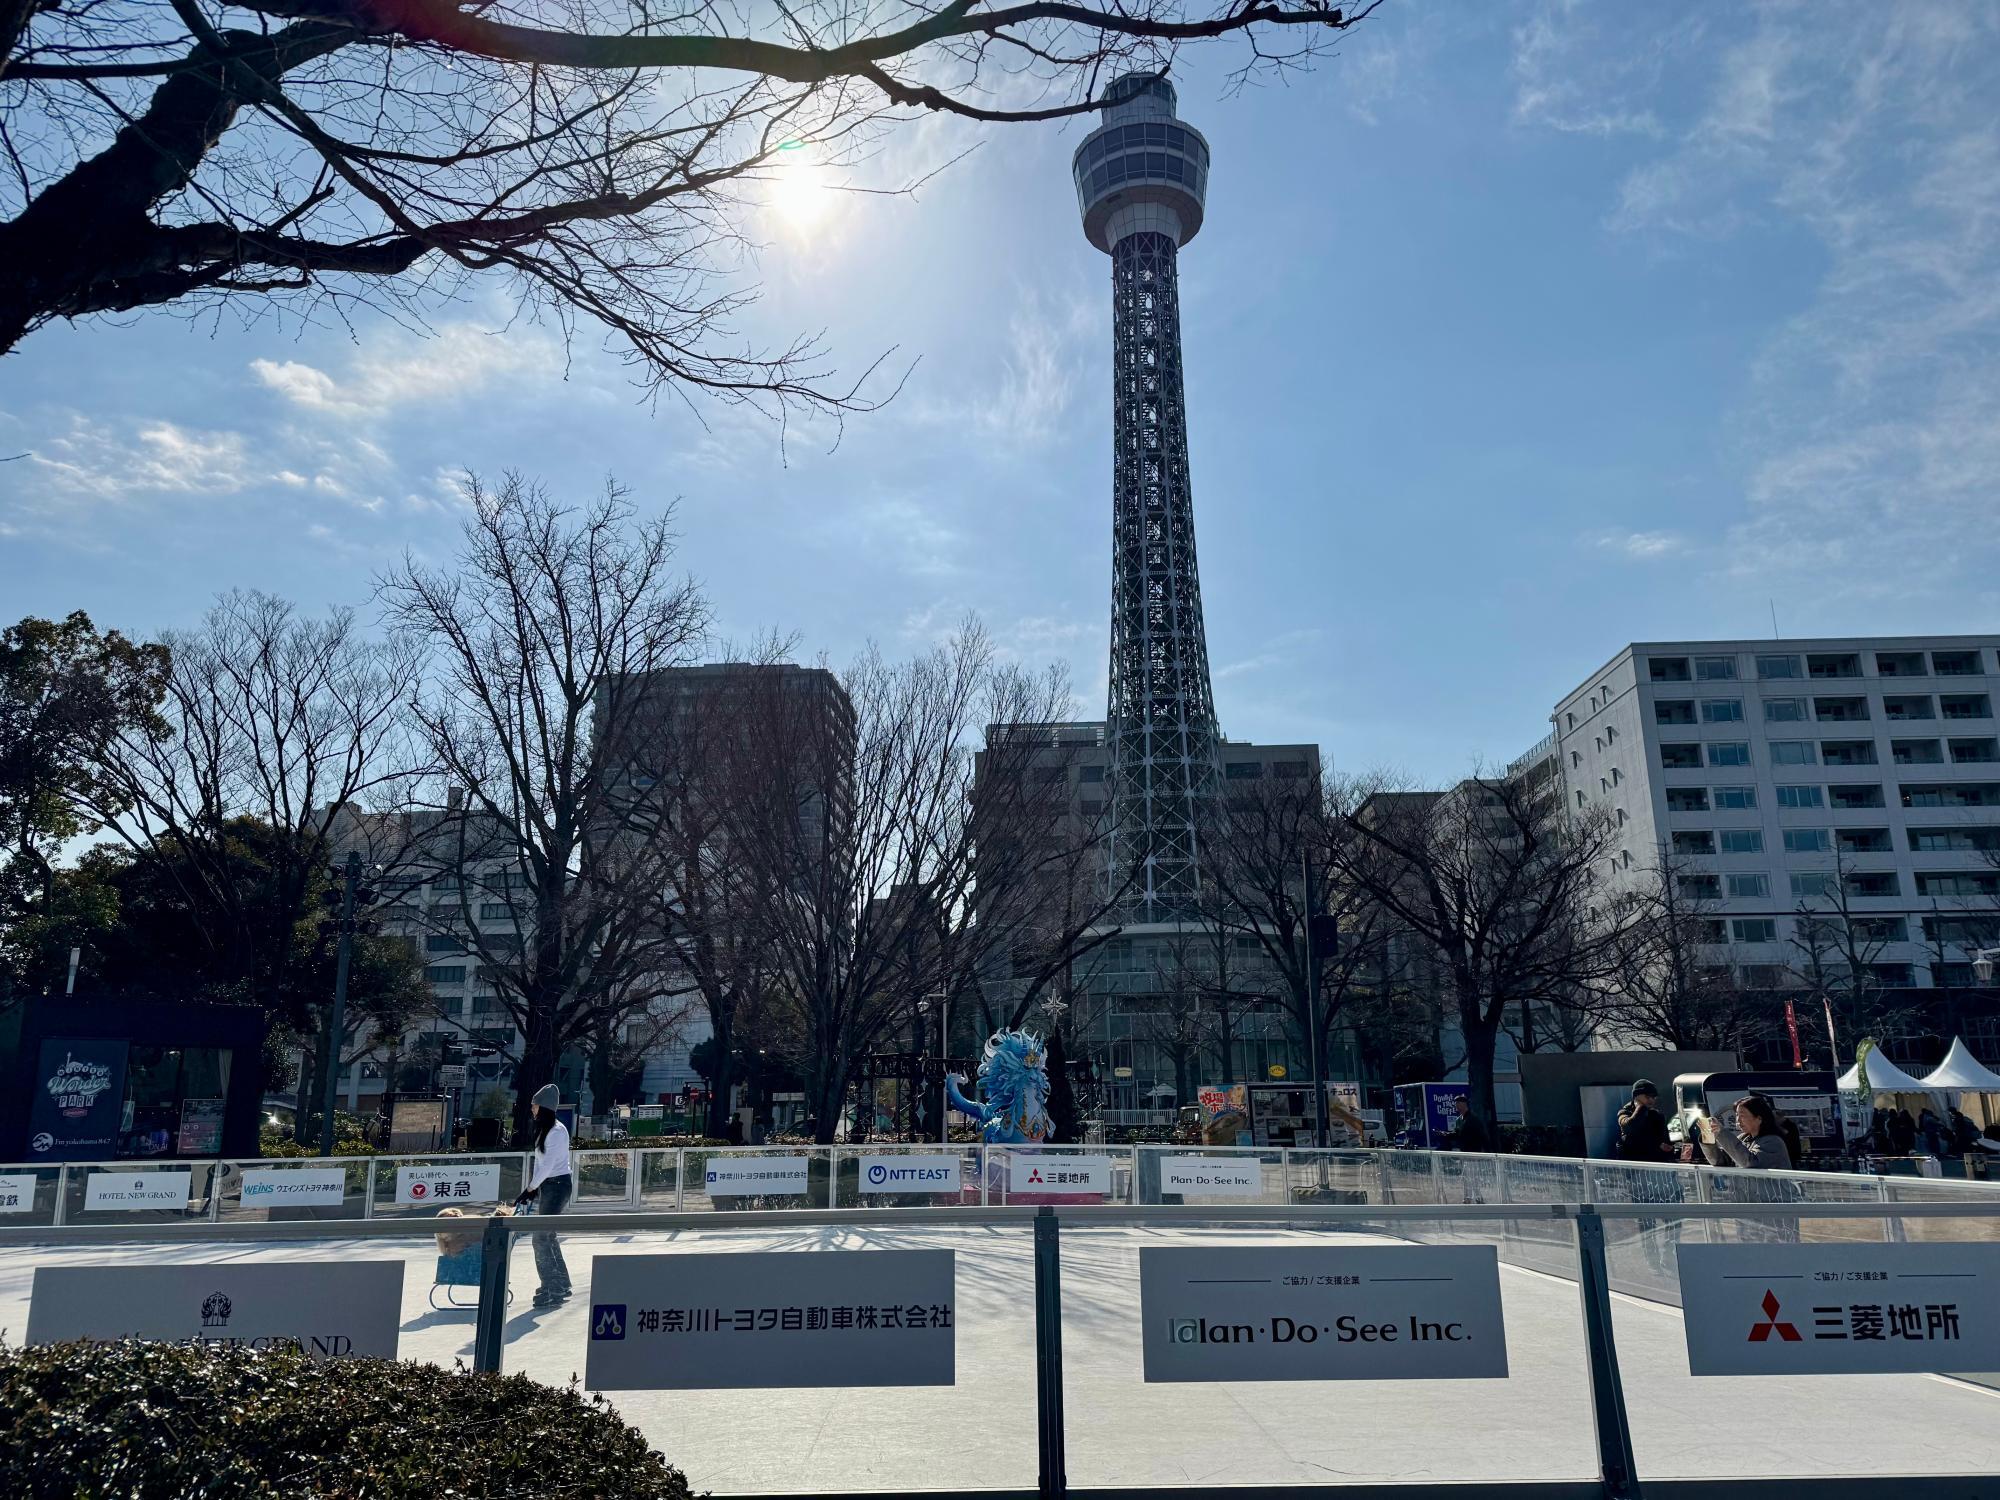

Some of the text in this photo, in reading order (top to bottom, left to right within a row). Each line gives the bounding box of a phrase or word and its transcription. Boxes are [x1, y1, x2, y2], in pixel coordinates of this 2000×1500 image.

[59, 1094, 94, 1108] PARK
[889, 1168, 950, 1180] NTT EAST
[1046, 1172, 1090, 1184] 三菱地所
[1234, 1176, 1253, 1185] Inc.
[98, 1191, 177, 1200] HOTEL NEW GRAND
[433, 1181, 472, 1198] 東急
[637, 1304, 953, 1333] 神奈川トヨタ自動車株式会社
[1812, 1303, 1960, 1341] 三菱地所
[1409, 1315, 1473, 1342] Inc.
